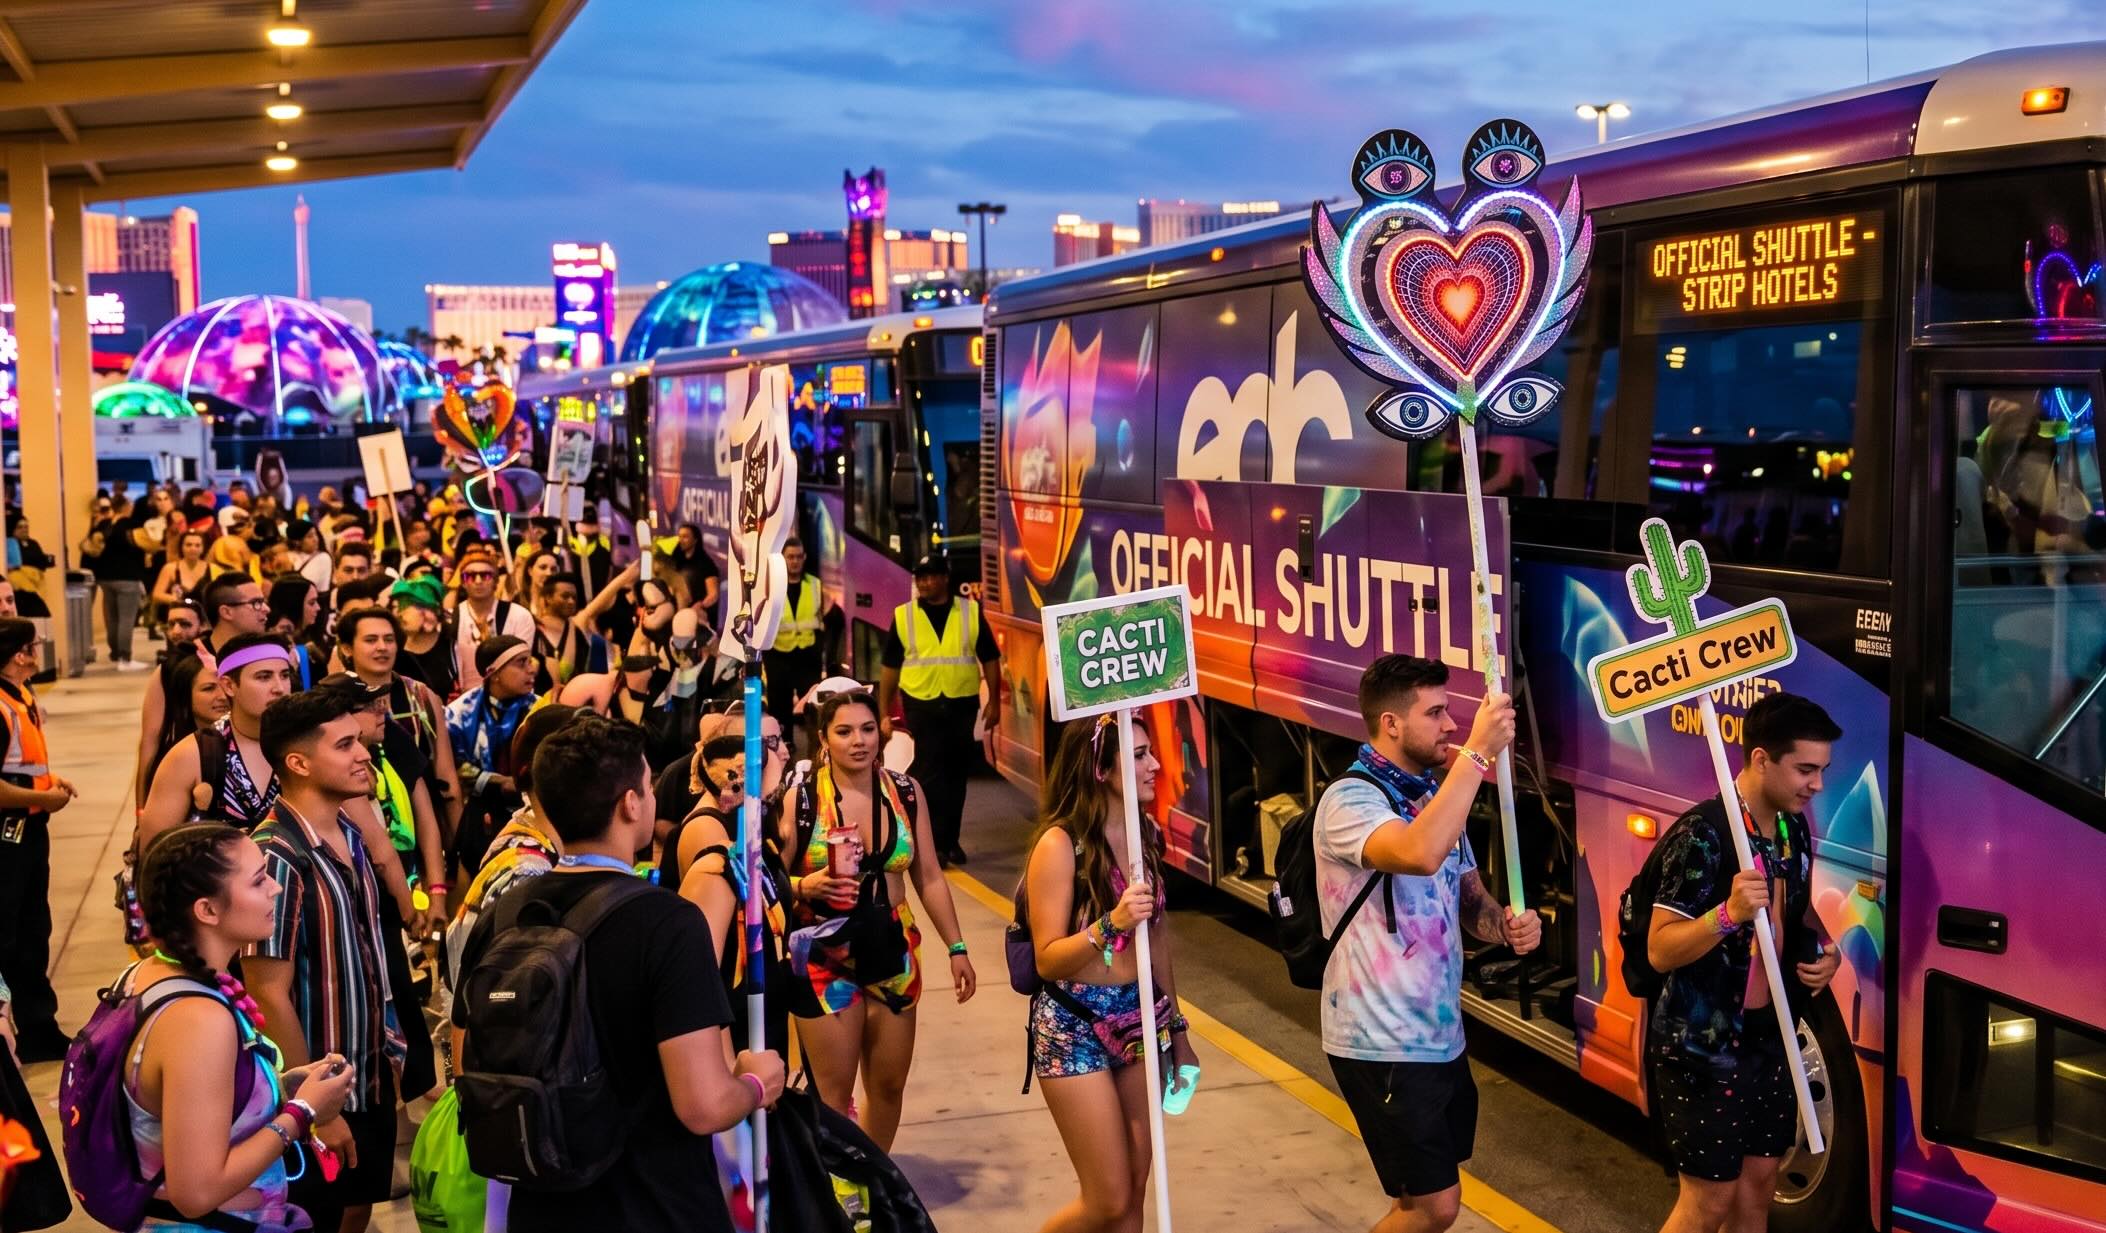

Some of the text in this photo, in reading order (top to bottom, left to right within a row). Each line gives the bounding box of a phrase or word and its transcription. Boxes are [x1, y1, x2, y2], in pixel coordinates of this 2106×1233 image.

[1653, 234, 1746, 278] OFFICIAL
[1752, 218, 1856, 267] SHUTTLE
[1682, 263, 1838, 312] STRIP HOTELS
[1111, 528, 1507, 674] OFFICIAL SHUTTLE
[1077, 617, 1166, 657] CACTI
[1609, 648, 1691, 699] Cacti
[1698, 625, 1777, 670] Crew
[1080, 647, 1168, 688] CREW
